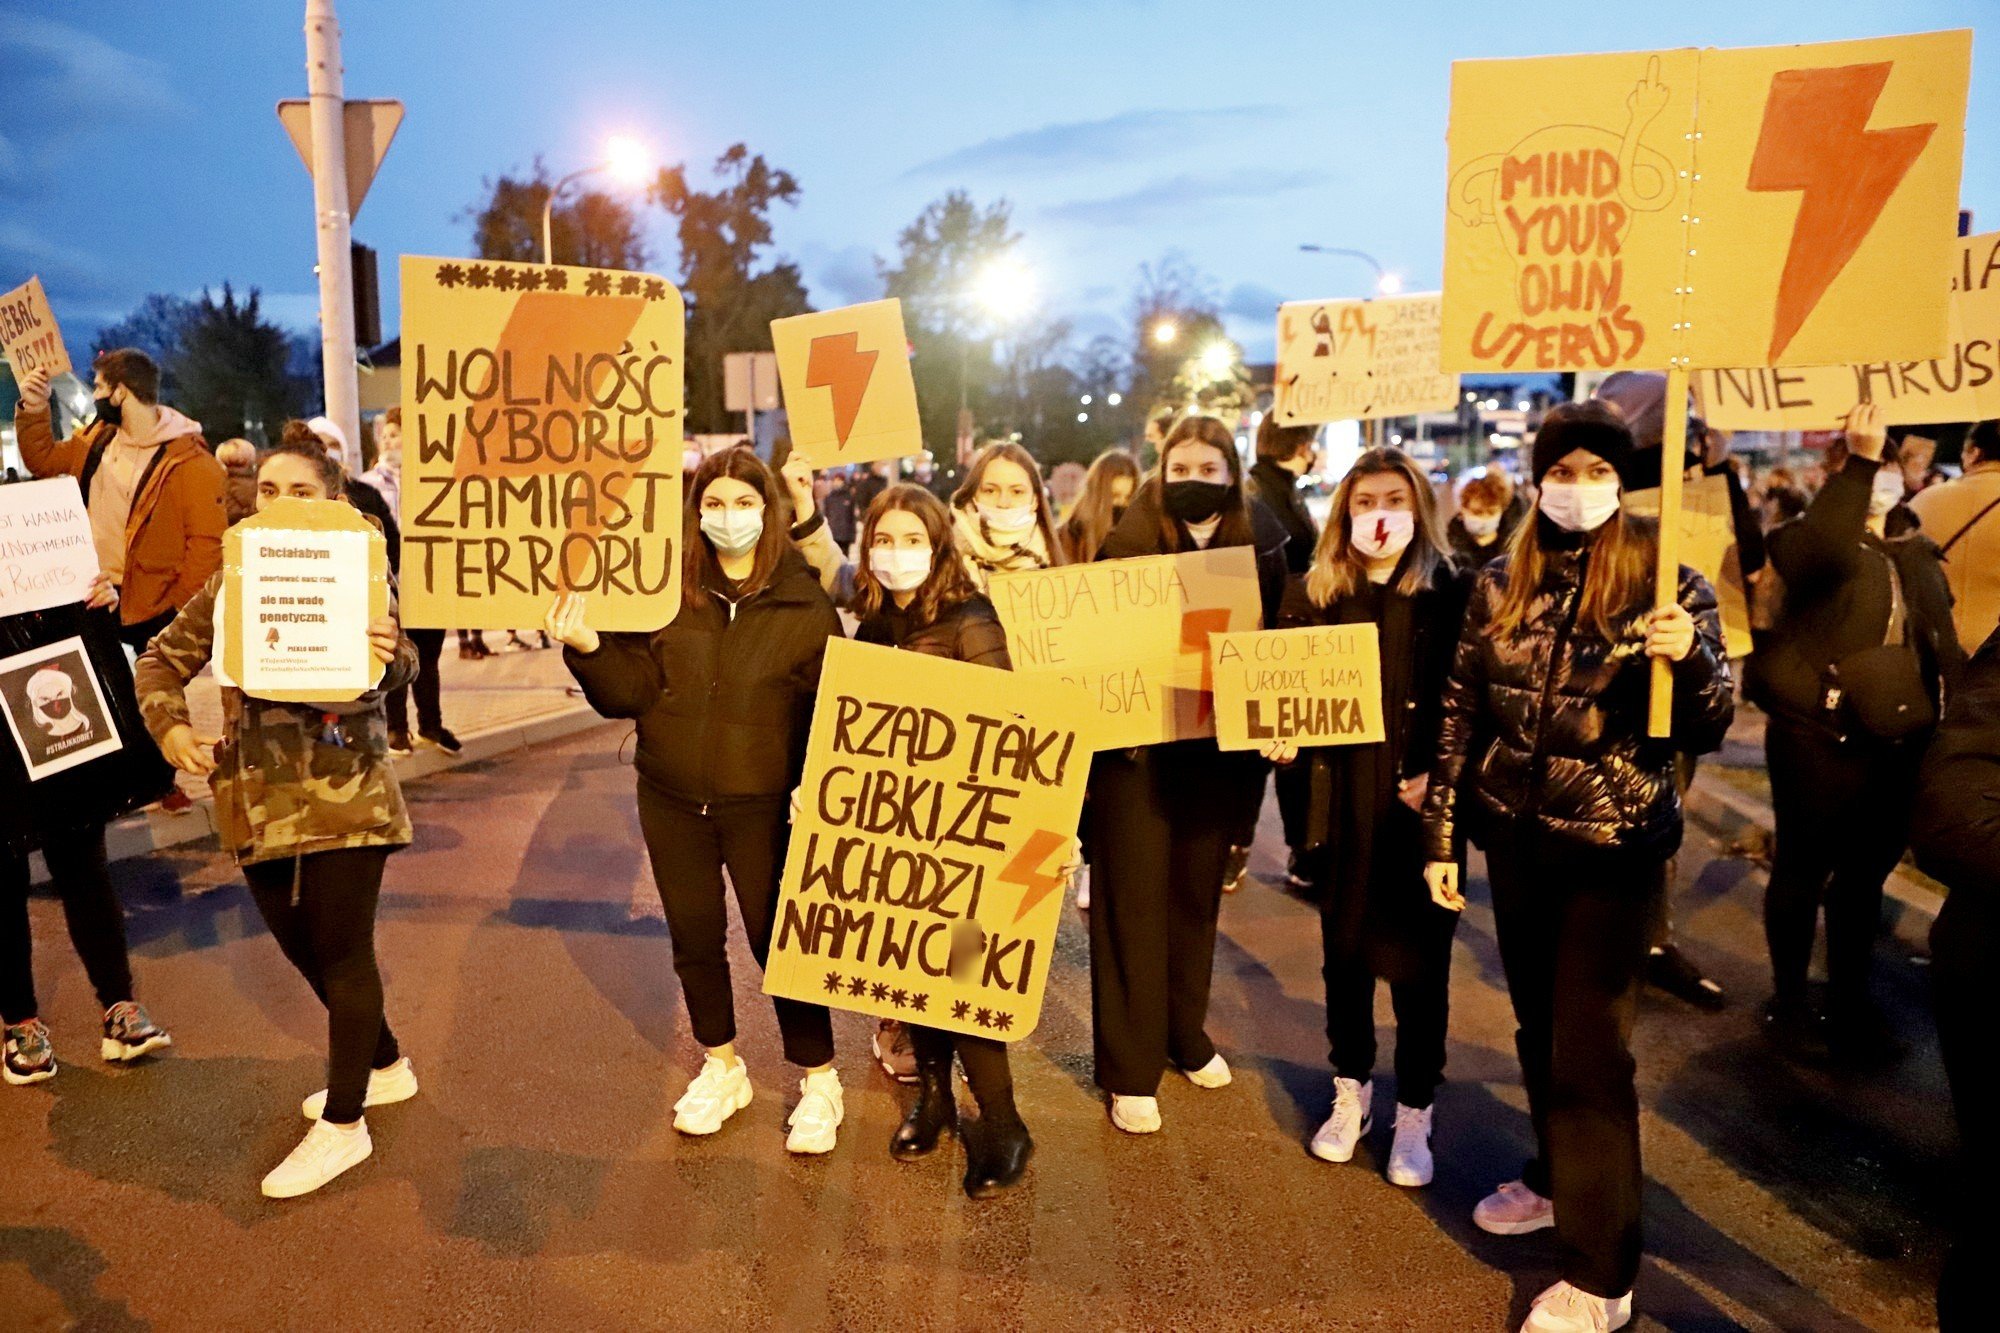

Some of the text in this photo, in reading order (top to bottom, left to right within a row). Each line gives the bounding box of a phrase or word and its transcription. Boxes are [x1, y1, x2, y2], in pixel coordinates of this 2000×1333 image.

[1501, 148, 1619, 201] MIND
[1504, 201, 1626, 257] YOUR
[1520, 259, 1623, 316] OWN
[1471, 304, 1645, 369] UTERUS
[415, 340, 675, 418] WOLNOŚĆ
[1714, 367, 1813, 411] NIE
[418, 406, 653, 465] WYBORU
[22, 508, 80, 527] WANNA
[414, 470, 673, 533] ZAMIAST
[5, 564, 76, 595] RIGHTS
[404, 533, 672, 597] TERRORU
[260, 595, 276, 604] ale
[297, 596, 324, 606] wadę
[1007, 566, 1189, 623] MOJA PUSIA
[1016, 627, 1065, 666] NIE
[1219, 630, 1355, 665] A CO JEŚLI
[1245, 668, 1362, 693] URODZĘ WAM
[833, 696, 1075, 786] RZĄD TAKI
[1246, 697, 1365, 739] LEWAKA
[945, 774, 1020, 851] ŻE
[800, 833, 984, 919] WCHODZI
[777, 899, 874, 962] NAM
[878, 917, 918, 970] W
